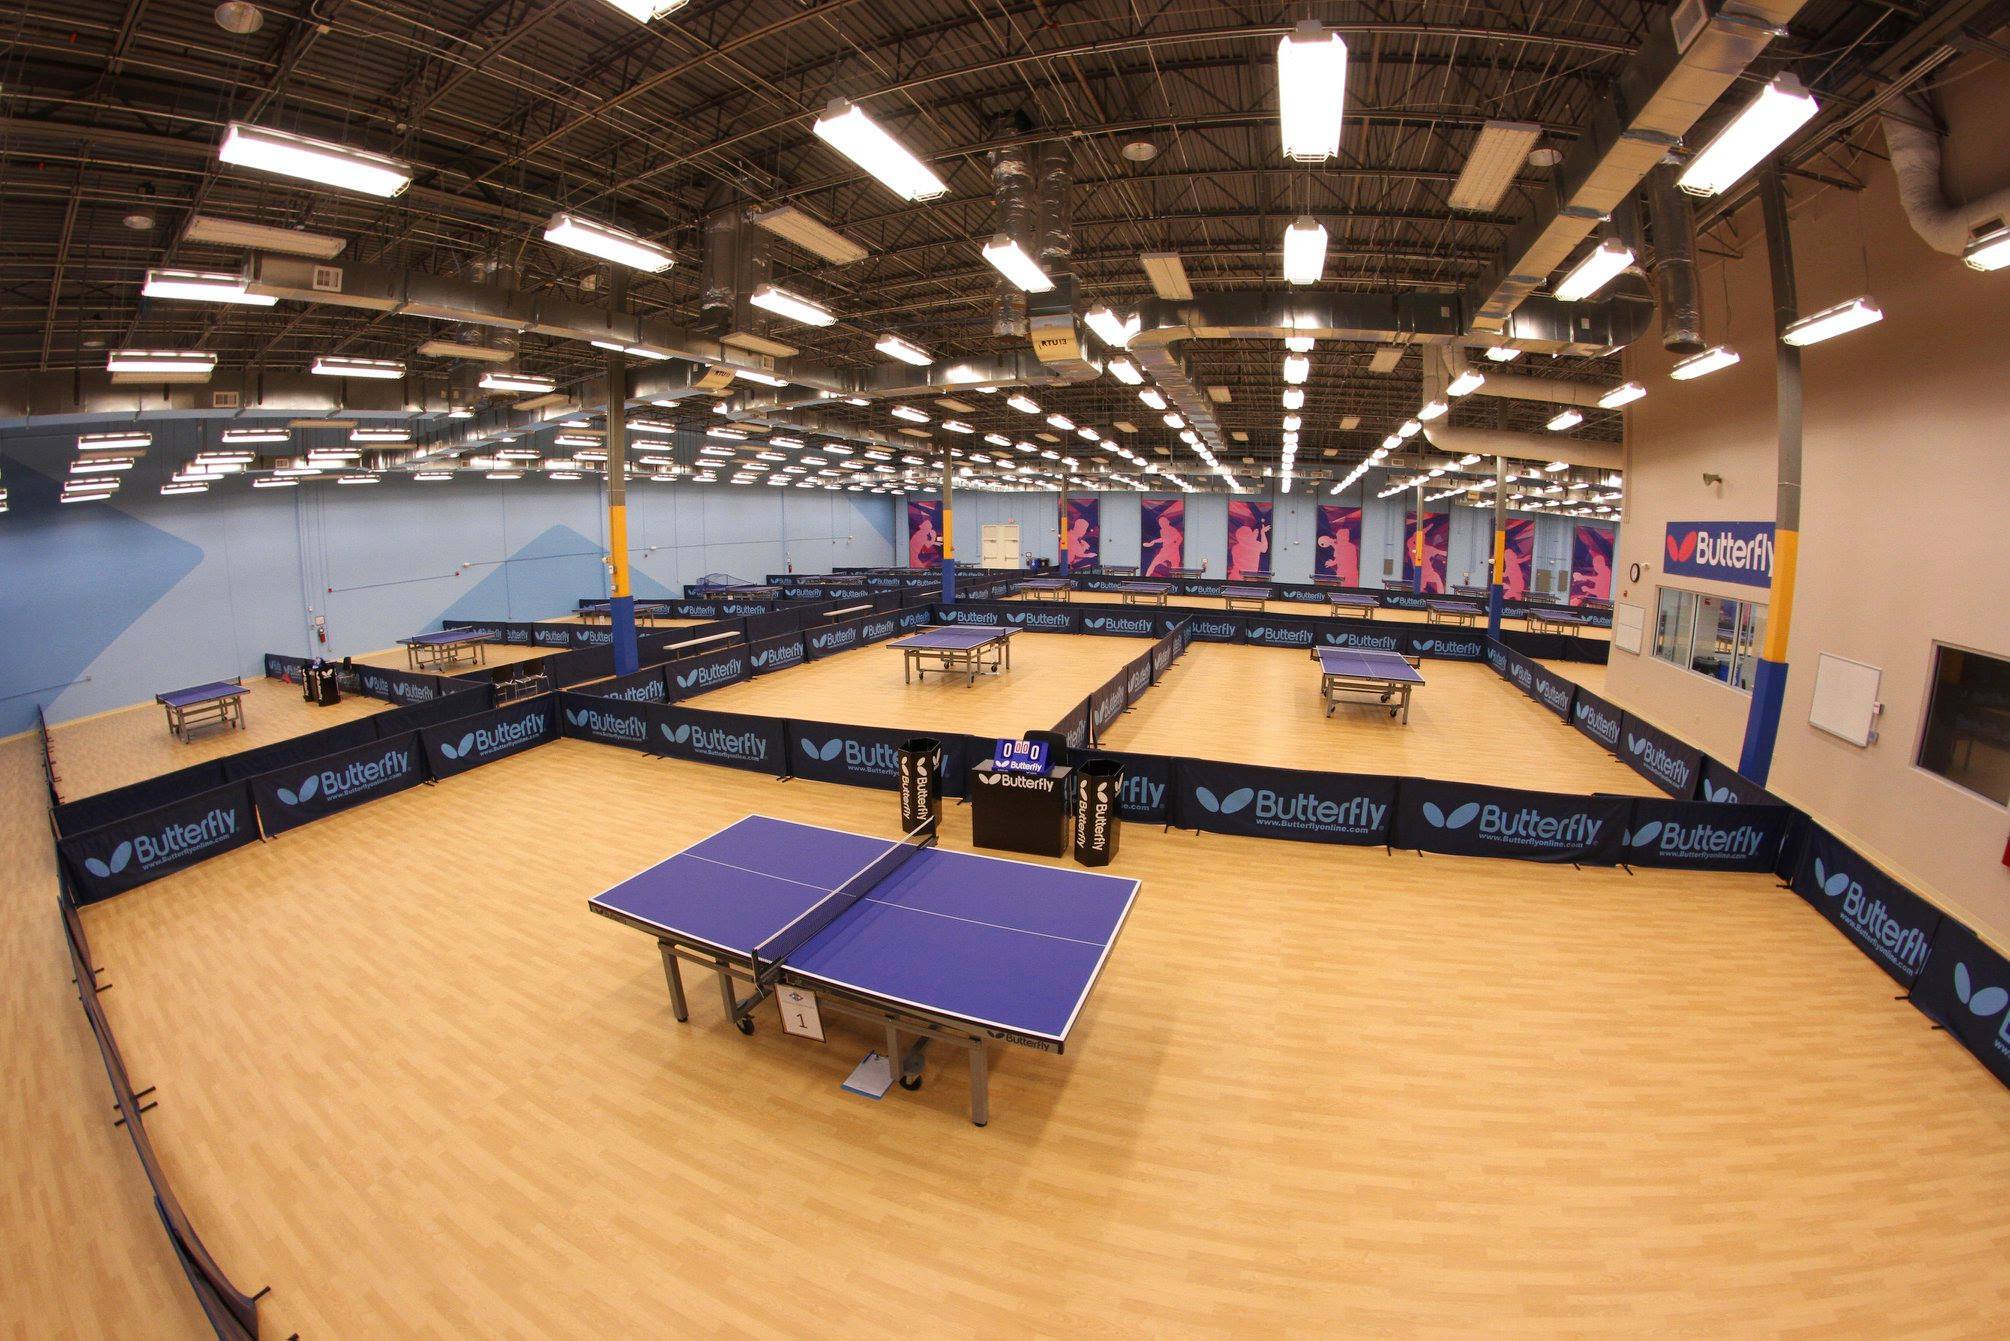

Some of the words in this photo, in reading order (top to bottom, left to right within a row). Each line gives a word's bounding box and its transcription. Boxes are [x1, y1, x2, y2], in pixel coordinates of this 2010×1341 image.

[796, 588, 821, 597] Butterfly
[1296, 591, 1325, 600] Butterfly
[689, 605, 716, 615] Butterfly
[737, 605, 766, 614] Butterfly
[958, 611, 998, 624] Butterfly
[868, 620, 894, 636] Butterfly
[1026, 612, 1070, 626] Butterfly
[1105, 618, 1152, 631] Butterfly
[545, 630, 570, 643] Butterfly
[827, 627, 856, 645] Butterfly
[1265, 628, 1313, 644] Butterfly
[1349, 635, 1397, 650] Butterfly
[768, 642, 804, 664] Butterfly
[1434, 640, 1482, 656] Butterfly
[698, 658, 741, 683] Butterfly
[1544, 682, 1569, 710] Butterfly
[475, 713, 545, 751] Butterfly
[589, 710, 647, 740] Butterfly
[1587, 707, 1621, 743] Butterfly
[691, 726, 767, 760] Butterfly
[1003, 743, 1012, 758] 0
[1030, 745, 1040, 760] 0
[321, 751, 409, 796] Butterfly
[1010, 761, 1042, 772] Butterfly
[1644, 741, 1690, 788] Butterfly
[1002, 774, 1055, 793] Butterfly
[902, 775, 910, 820] Butterfly
[916, 777, 928, 821] Butterfly
[1255, 789, 1386, 831] Butterfly
[1077, 800, 1088, 849] Butterfly
[1092, 803, 1108, 851] Butterfly
[1256, 817, 1369, 834] www.Butterflyonline.com
[1479, 804, 1602, 845] Butterfly
[134, 808, 236, 864] Butterfly
[1478, 832, 1584, 848] www.Butterflyonline.com
[1660, 822, 1764, 856] Butterfly
[1843, 880, 1932, 976] Butterfly
[797, 1014, 808, 1028] 1
[1006, 1033, 1050, 1051] Butterfly
